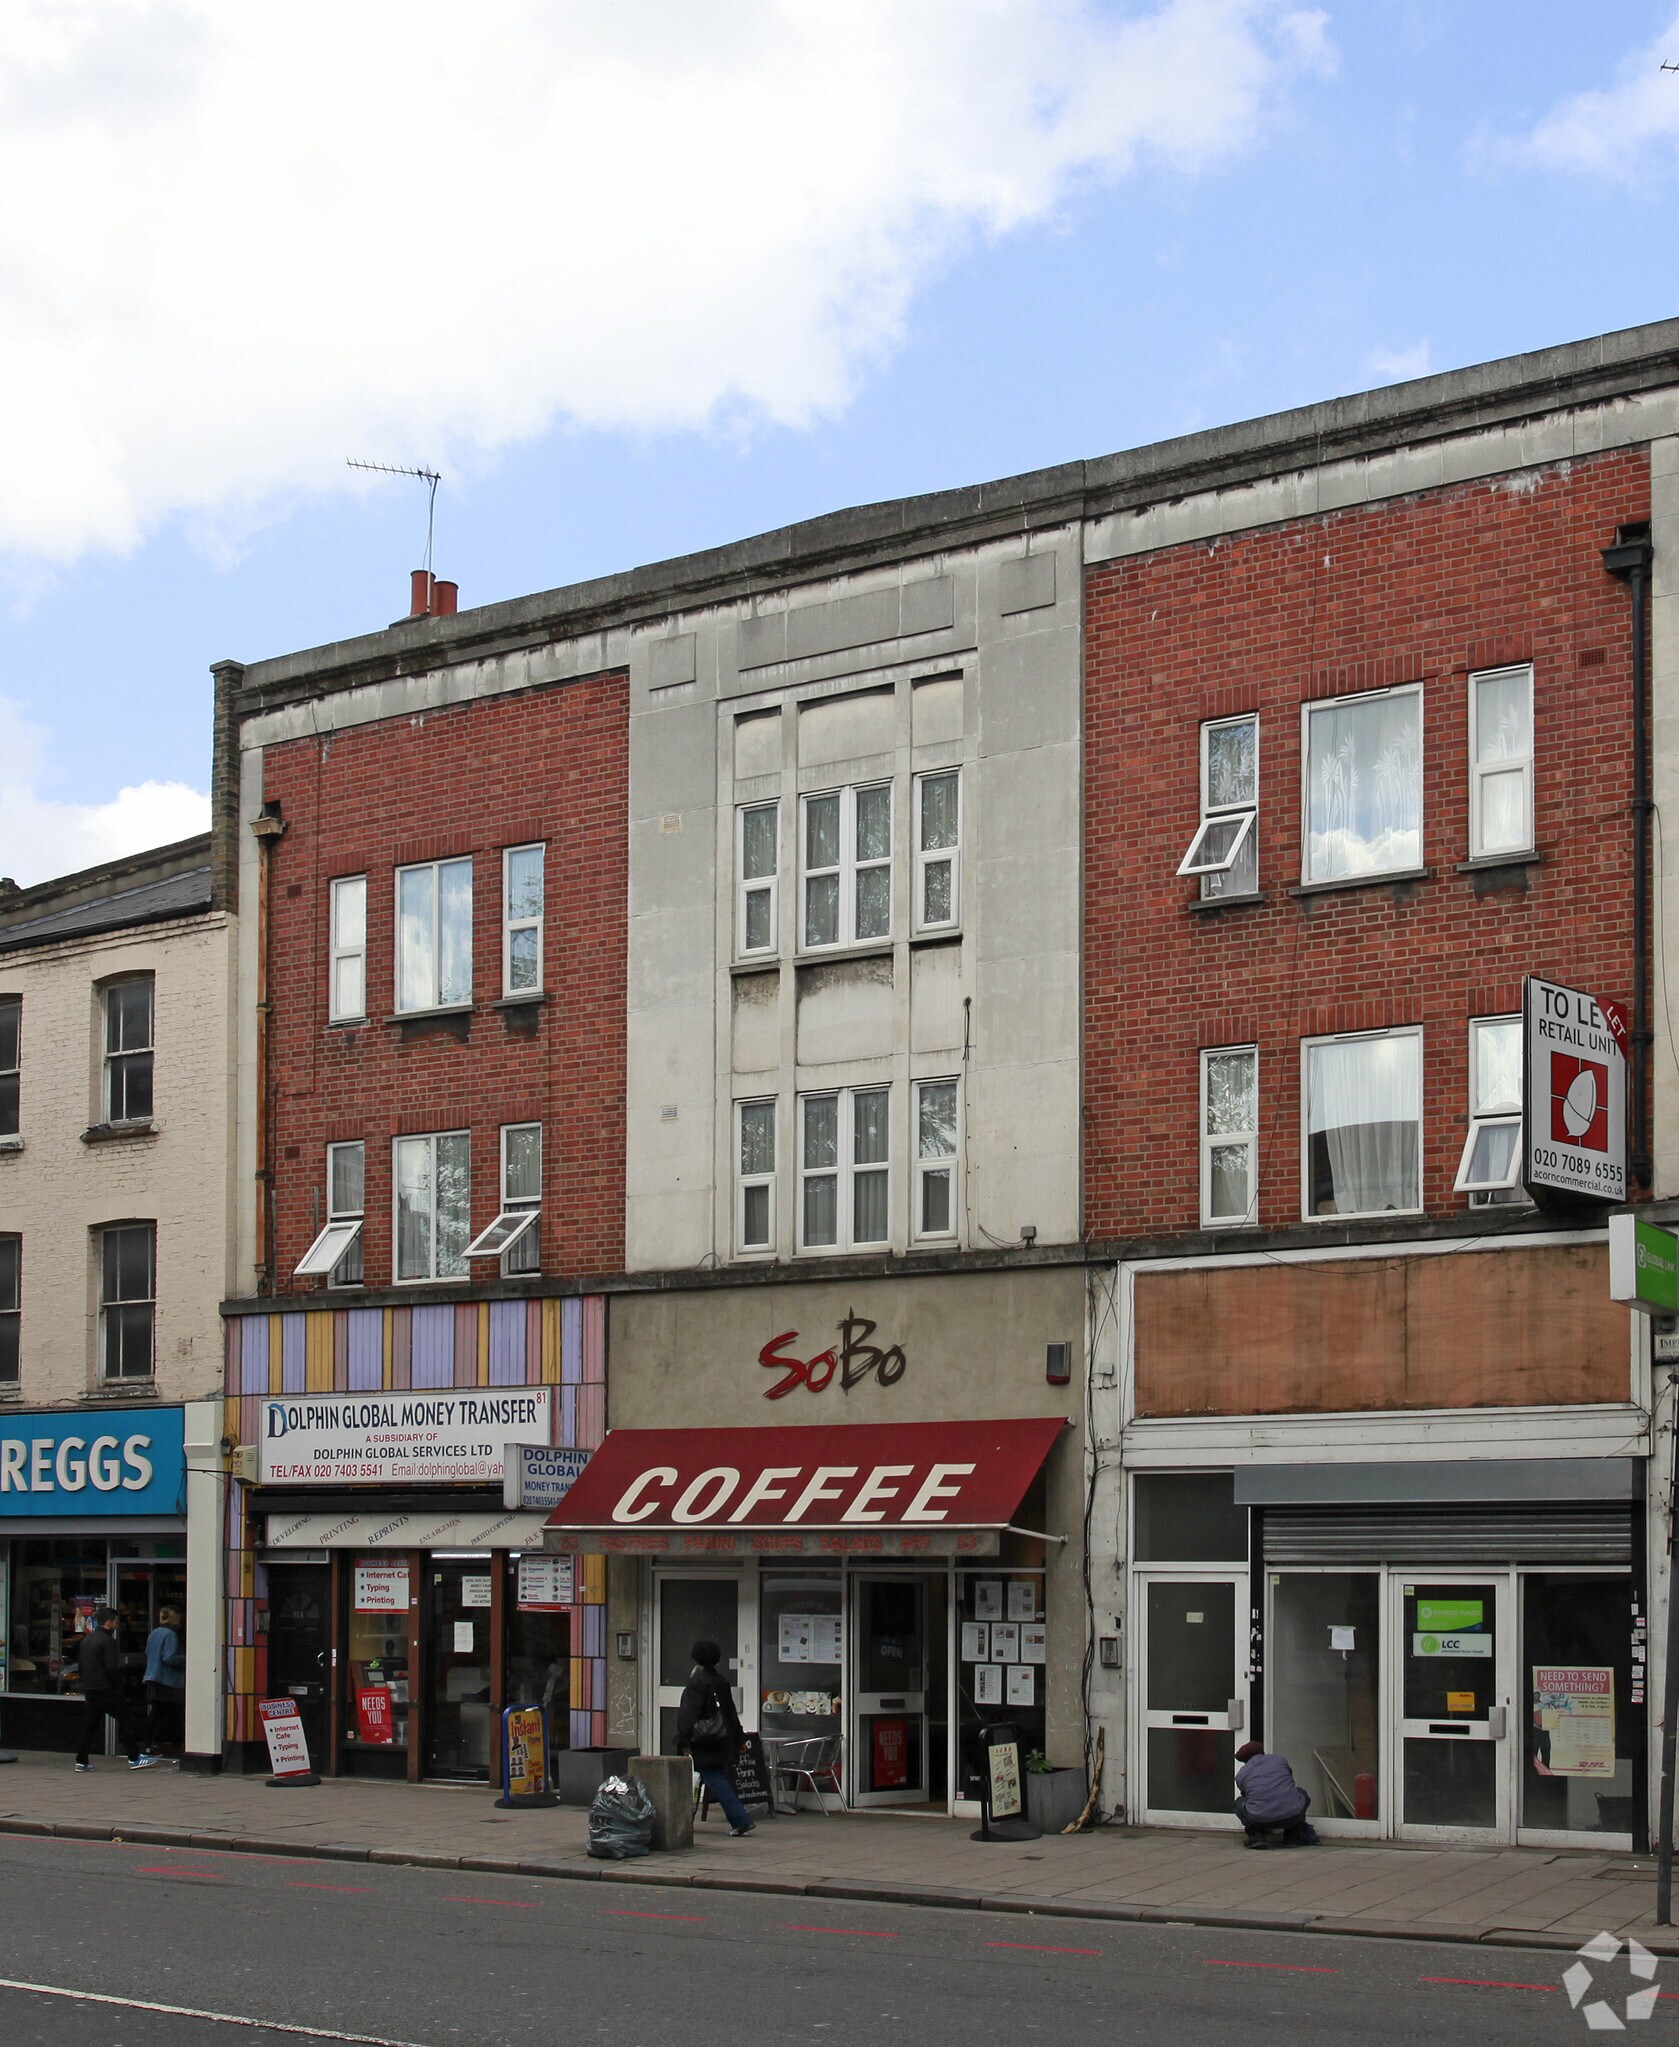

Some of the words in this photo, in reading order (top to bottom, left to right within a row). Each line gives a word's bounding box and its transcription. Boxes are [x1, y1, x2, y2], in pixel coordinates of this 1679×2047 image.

[1540, 986, 1569, 1019] TO
[1577, 997, 1610, 1032] LE
[1606, 1005, 1626, 1036] LET
[1539, 1018, 1585, 1047] RETAIL
[1589, 1032, 1618, 1056] UNIT
[1534, 1148, 1557, 1168] 020
[1561, 1154, 1591, 1175] 7089
[1595, 1161, 1623, 1182] 6555
[1533, 1169, 1624, 1196] acorncommercial.co.uk
[536, 1391, 547, 1404] 81
[267, 1402, 339, 1438] DOLPHIN
[342, 1403, 398, 1429] GLOBAL
[401, 1401, 455, 1426] MONEY
[459, 1398, 537, 1425] TRANSFER
[365, 1435, 372, 1443] A
[373, 1433, 424, 1443] SUBSIDIARY
[426, 1432, 438, 1441] OF
[313, 1448, 363, 1460] DOLPHIN
[365, 1446, 409, 1458] GLOBAL
[412, 1445, 467, 1457] SERVICES
[470, 1444, 493, 1456] LTD
[523, 1449, 588, 1465] DOLPHIN
[0, 1434, 153, 1492] REGGS
[270, 1464, 312, 1478] TEL/FAX
[314, 1465, 332, 1477] 020
[334, 1464, 358, 1477] 7403
[360, 1464, 384, 1476] 5541
[524, 1481, 550, 1491] MONEY
[611, 1463, 976, 1523] COFFEE
[272, 1514, 312, 1546] DEVELOPING
[319, 1514, 360, 1545] PRINTING
[367, 1514, 410, 1545] REPRINTS
[470, 1528, 491, 1546] PHOTO
[489, 1514, 516, 1533] COPYING
[524, 1532, 539, 1546] FAX
[560, 1535, 579, 1550] 83
[599, 1535, 670, 1551] PASTRIES
[683, 1535, 737, 1550] PANINI
[752, 1534, 804, 1551] SOUPS
[818, 1534, 885, 1551] SALADS
[366, 1571, 396, 1579] Internet
[366, 1583, 390, 1592] Typing
[366, 1596, 395, 1605] Printing
[880, 1645, 903, 1659] OPEN
[1441, 1640, 1460, 1649] LCC
[1540, 1672, 1565, 1681] NEED
[1567, 1672, 1580, 1681] TO
[1581, 1673, 1607, 1682] SEND
[1543, 1682, 1605, 1693] SOMETHING?
[261, 1701, 295, 1711] BUSINESS
[361, 1696, 386, 1711] NEEDS
[268, 1708, 294, 1717] CENTRE
[367, 1710, 382, 1725] YOU
[274, 1724, 300, 1733] Internet
[511, 1717, 541, 1739] Instant
[278, 1743, 299, 1751] Typing
[280, 1753, 305, 1763] Printing
